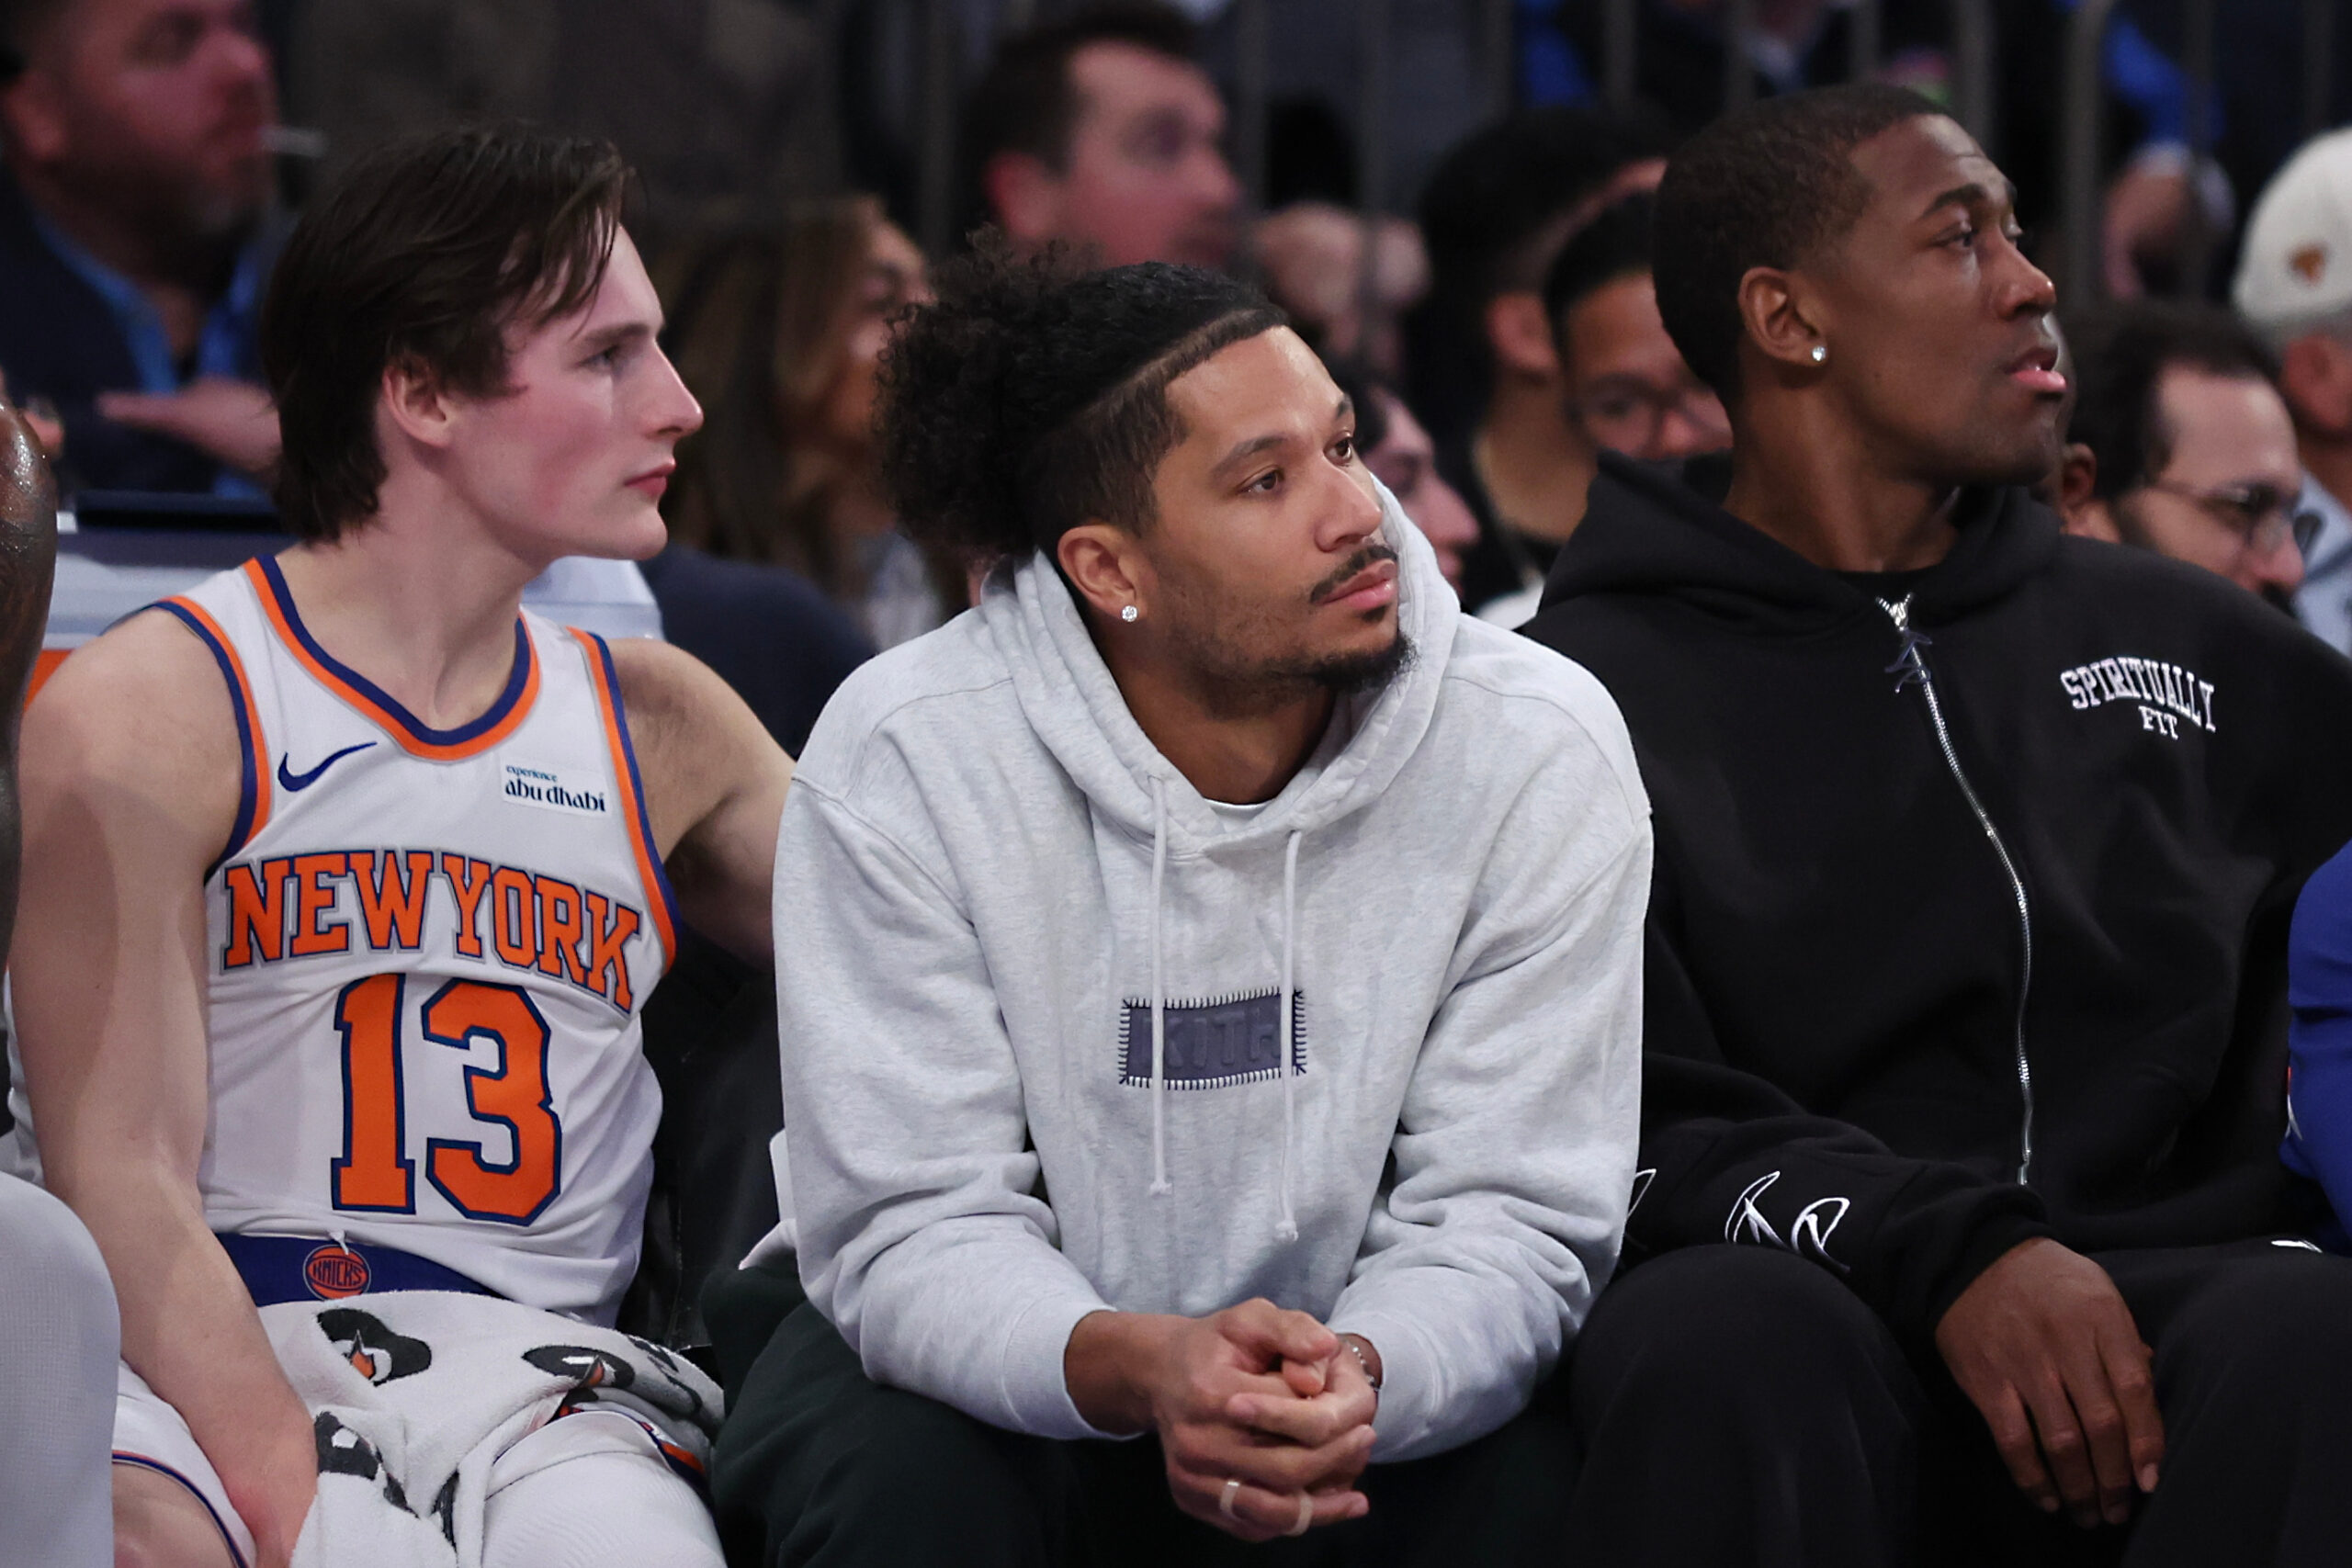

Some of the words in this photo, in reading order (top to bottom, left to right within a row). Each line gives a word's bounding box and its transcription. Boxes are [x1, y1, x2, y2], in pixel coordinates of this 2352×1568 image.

[2060, 657, 2216, 733] SPIRITUALLY
[2138, 705, 2178, 740] FIT
[505, 765, 558, 782] experience
[504, 778, 542, 801] abu
[546, 786, 605, 812] dhabi
[221, 850, 435, 972] NEW
[441, 852, 642, 1016] YORK
[330, 971, 562, 1227] 13
[312, 1259, 363, 1287] KNICKS
